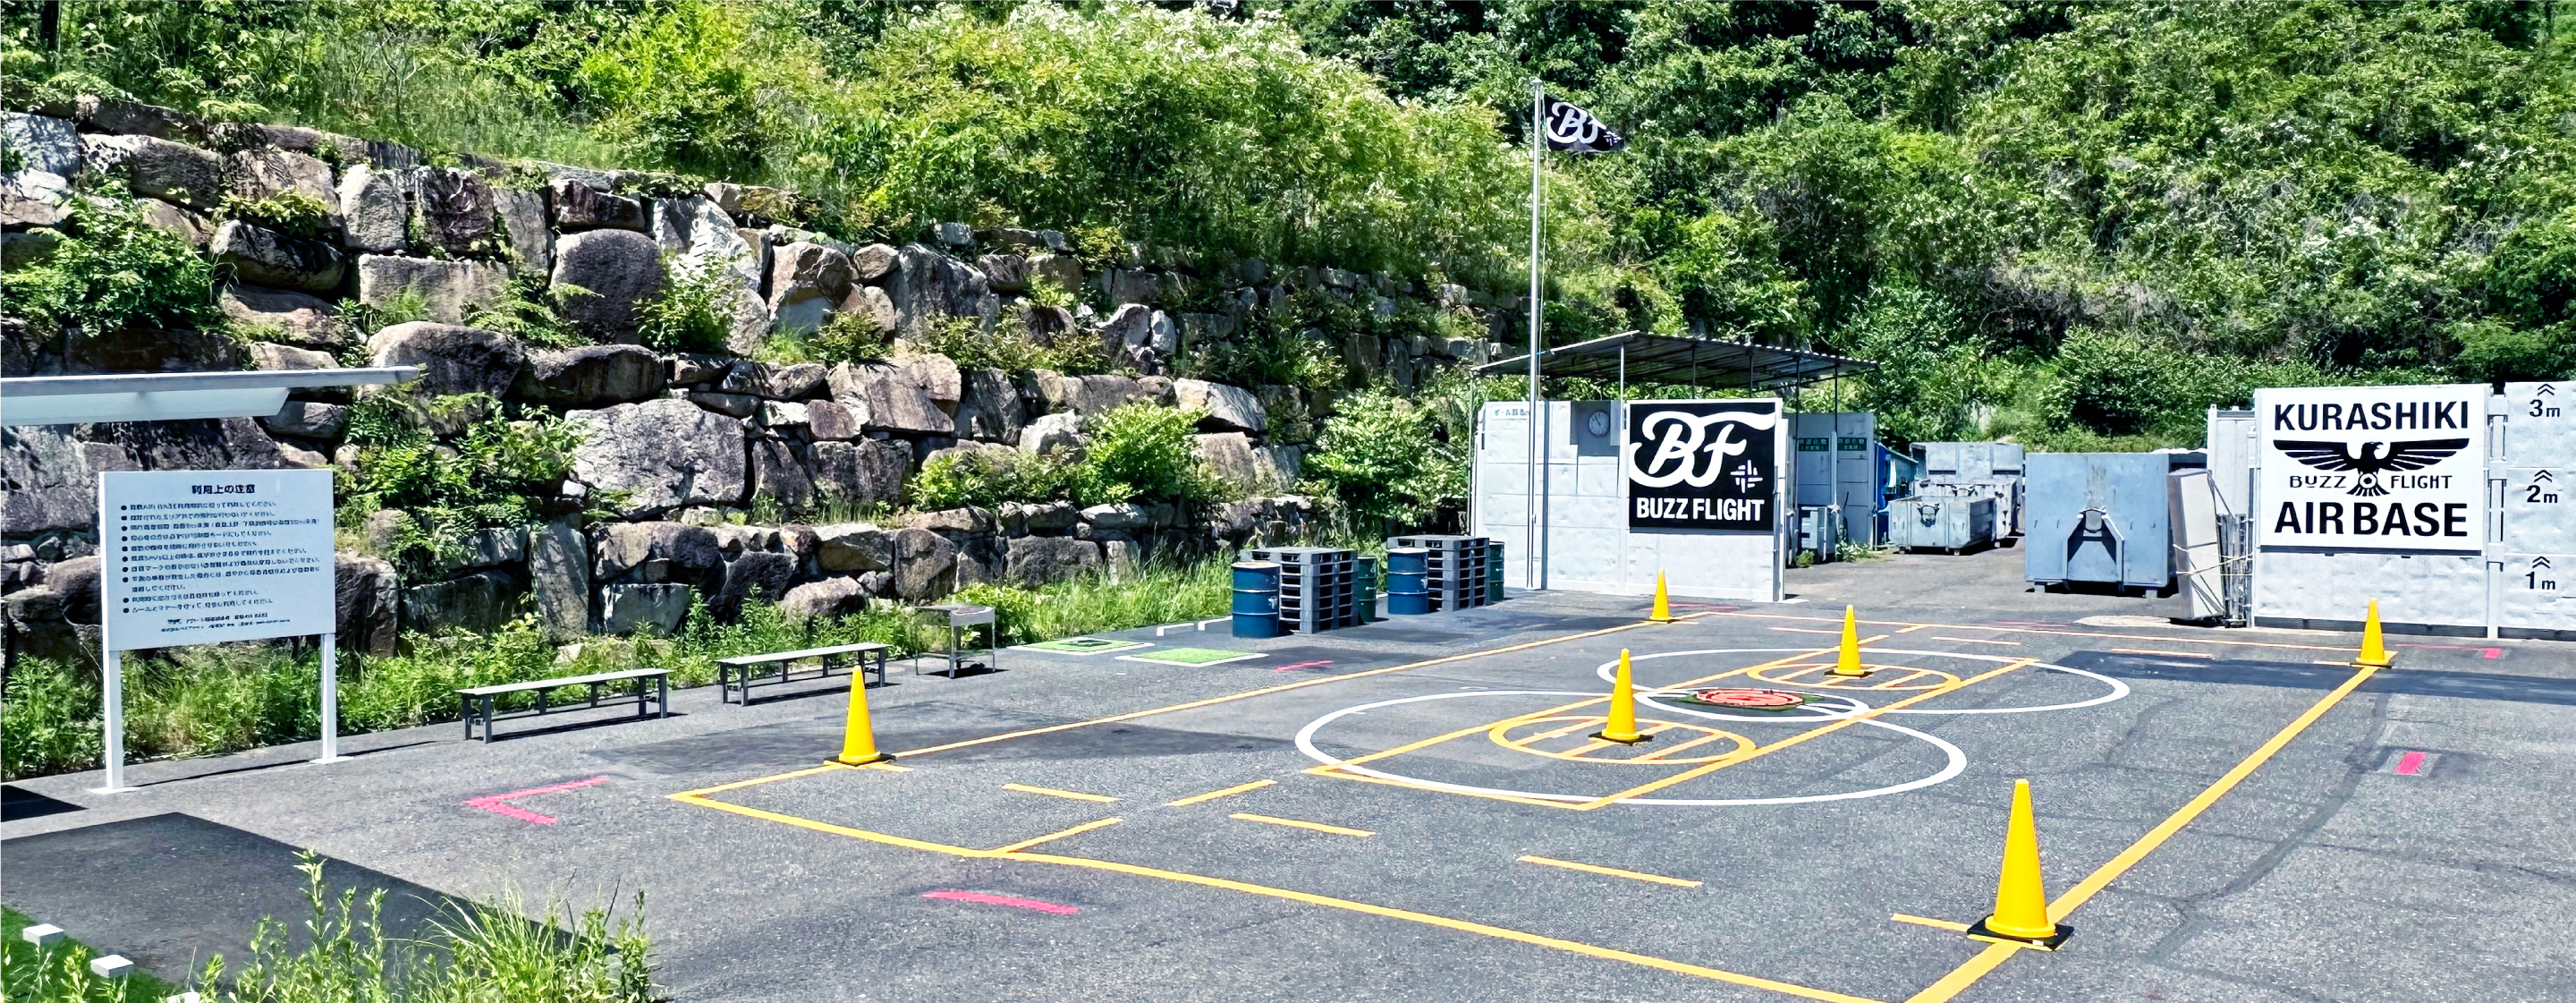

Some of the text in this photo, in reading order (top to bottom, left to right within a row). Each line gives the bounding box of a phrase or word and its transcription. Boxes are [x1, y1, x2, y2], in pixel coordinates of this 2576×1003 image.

[2275, 401, 2468, 430] KURASHIKI
[2290, 475, 2453, 489] BUZZ FLIGHT
[1636, 497, 1766, 523] BUZZ FLIGHT
[2274, 501, 2468, 537] AIR BASE
